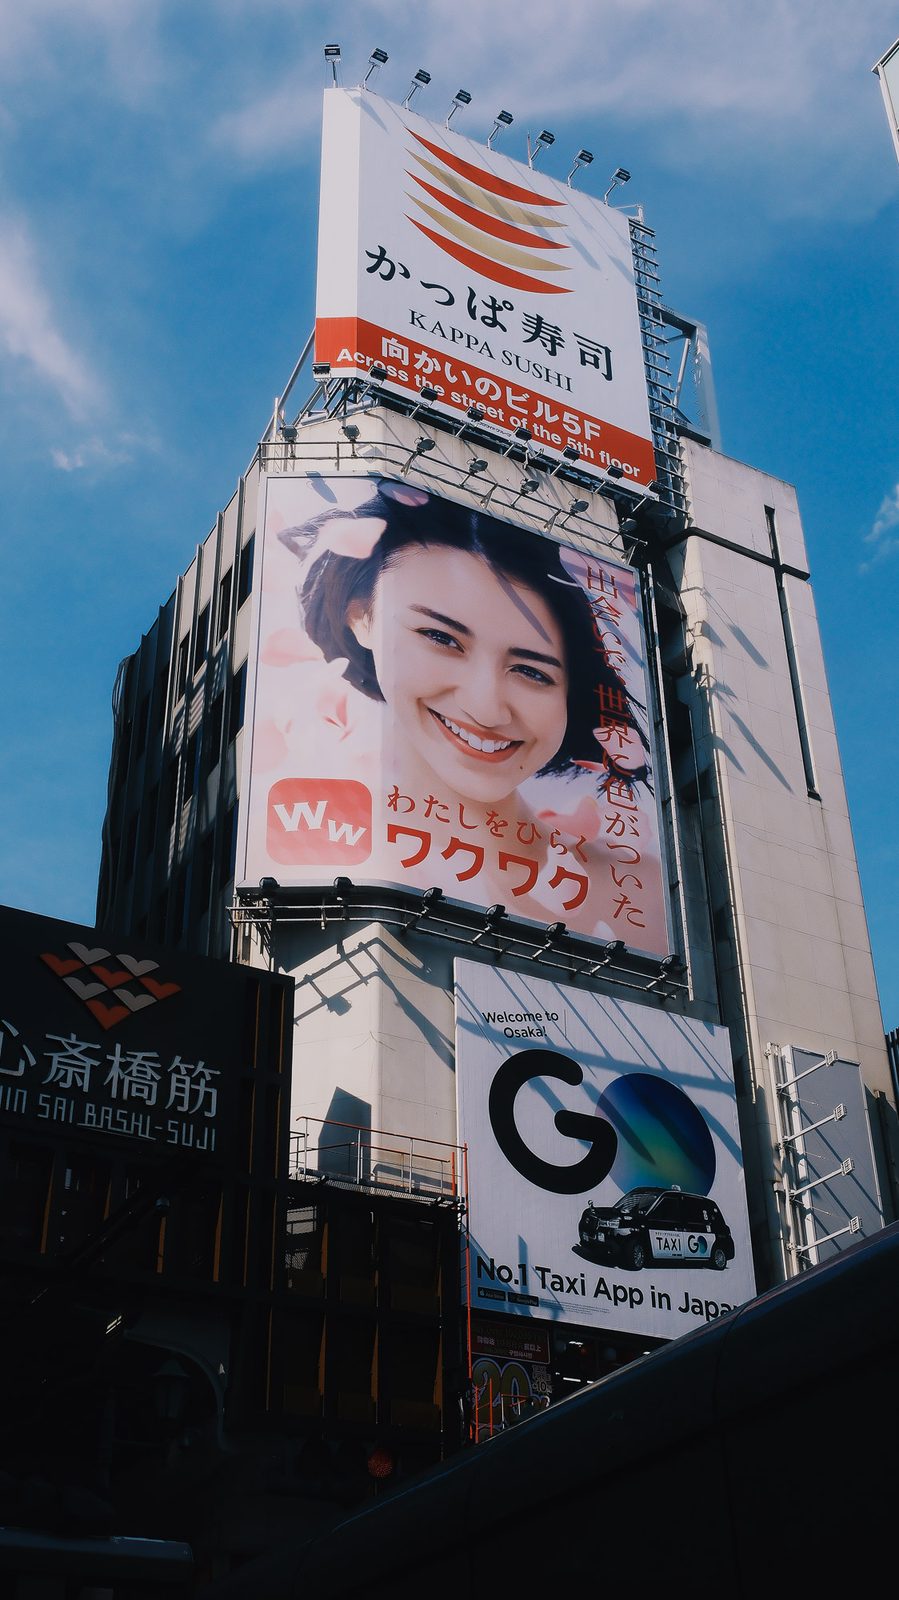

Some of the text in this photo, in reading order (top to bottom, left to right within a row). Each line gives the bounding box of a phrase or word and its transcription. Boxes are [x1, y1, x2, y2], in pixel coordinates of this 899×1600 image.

[365, 245, 614, 381] かっぱ寿司
[409, 309, 574, 393] KAPPA SUSHI
[336, 347, 641, 478] Across the street of the 5th floor
[380, 337, 601, 441] 向かいのビル5F
[387, 784, 591, 864] わたしをひらく
[387, 823, 590, 911] ワクワク
[482, 1010, 559, 1025] Welcome to
[503, 1024, 548, 1040] Osaka!
[0, 1019, 221, 1118] 心斎橋筋
[0, 1085, 28, 1114] IN
[488, 1048, 717, 1196] GO
[655, 1234, 708, 1254] TAXI GO
[476, 1255, 528, 1285] No.1
[536, 1267, 587, 1297] Taxi
[593, 1276, 645, 1309] App
[650, 1285, 672, 1311] in
[678, 1291, 739, 1322] Japa
